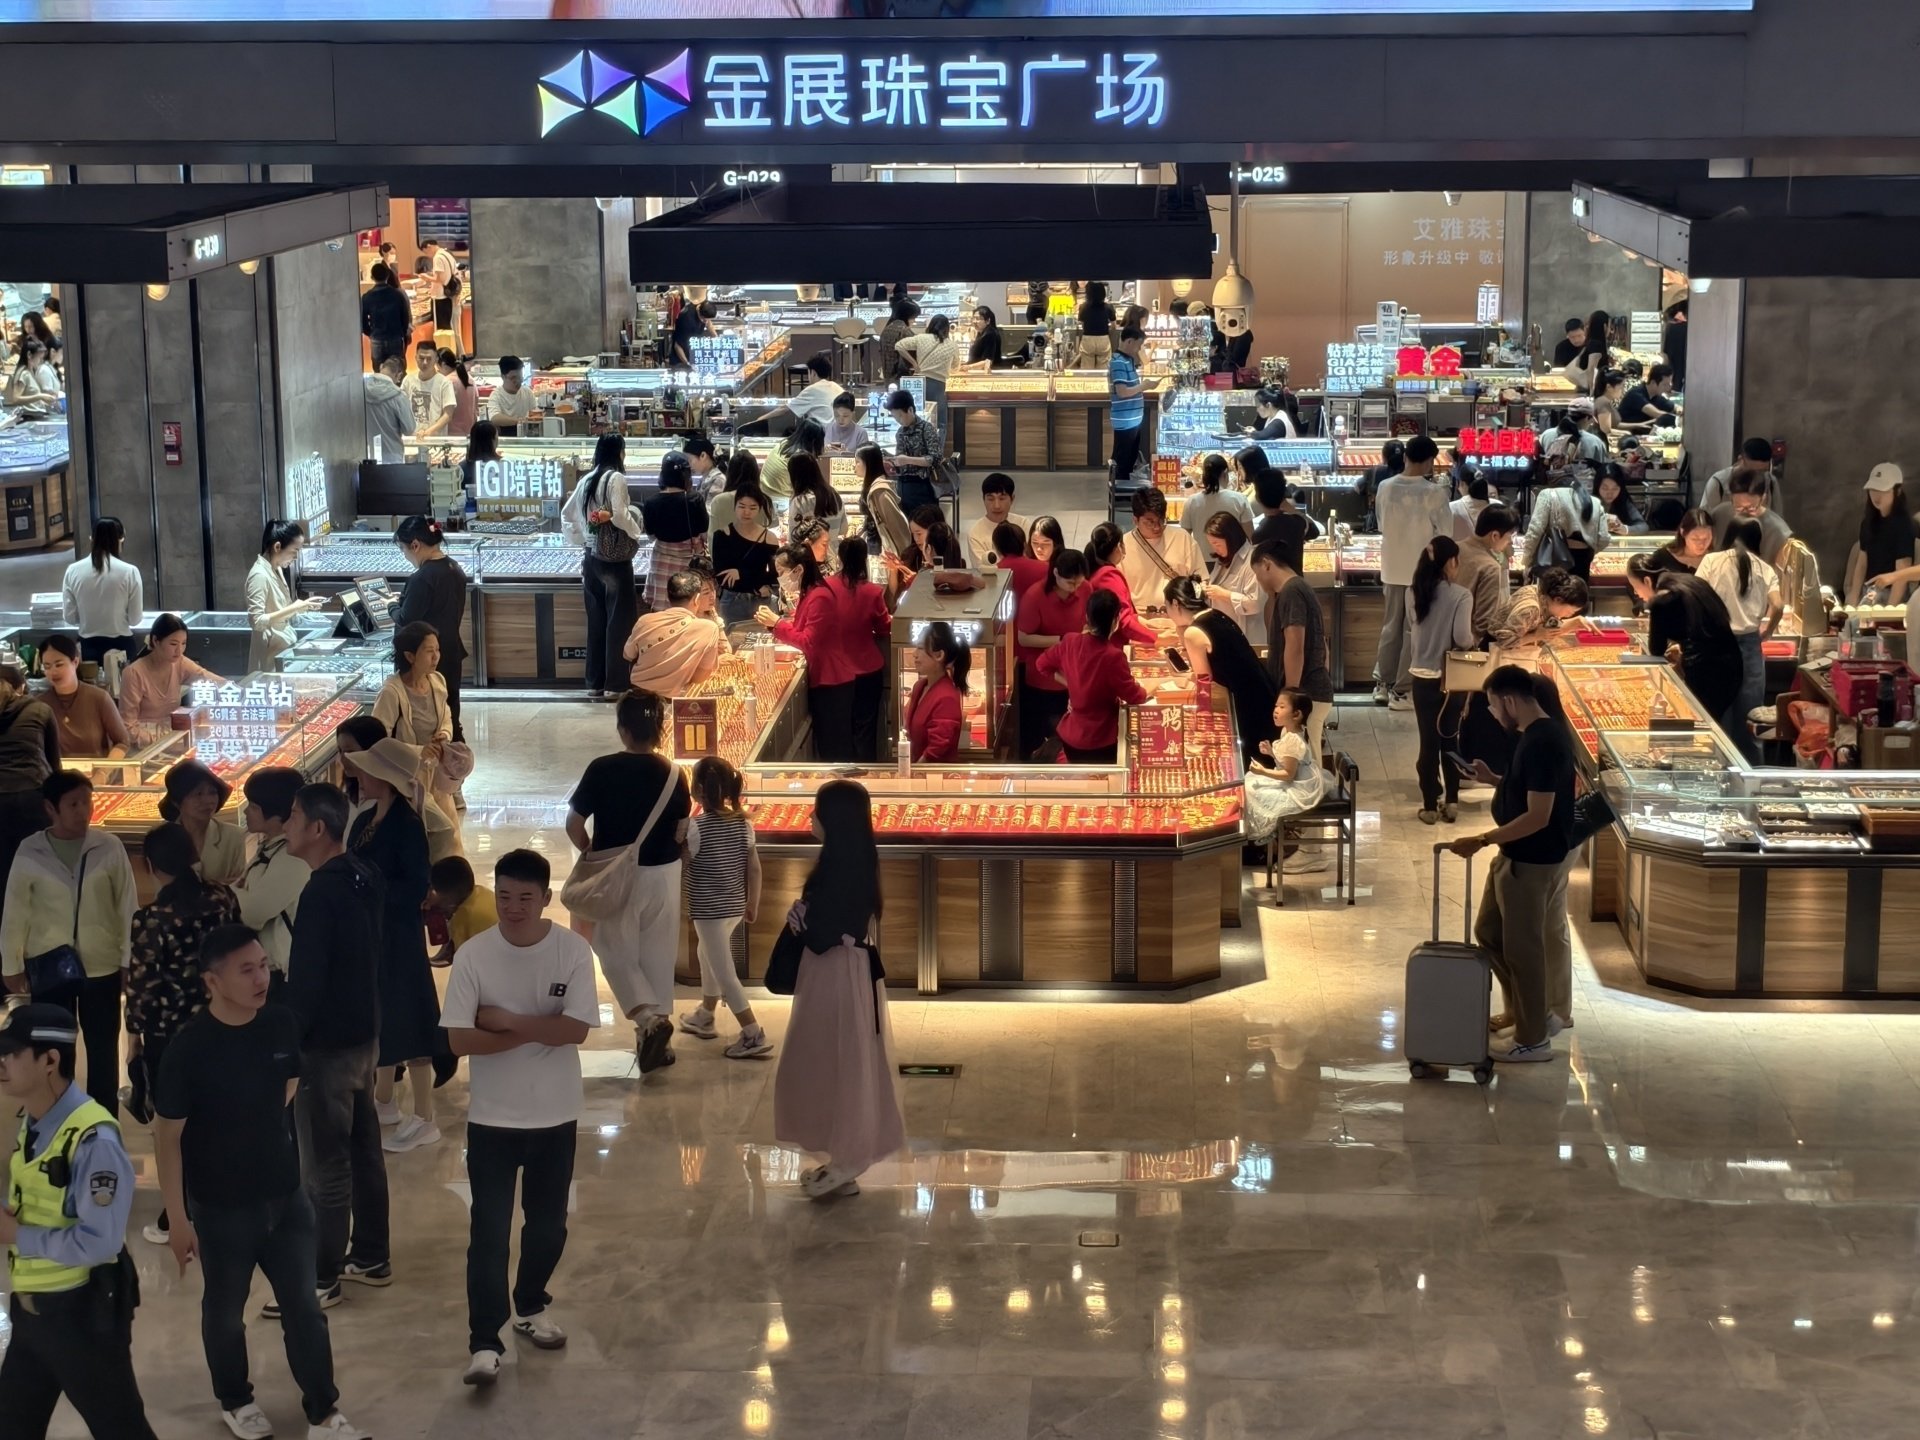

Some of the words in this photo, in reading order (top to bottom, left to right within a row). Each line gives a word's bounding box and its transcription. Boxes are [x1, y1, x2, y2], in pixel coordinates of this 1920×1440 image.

[704, 53, 1165, 127] 金展珠宝广场
[723, 170, 780, 186] G-029
[1384, 249, 1469, 265] 形象升级中
[1396, 345, 1462, 376] 黄金
[1459, 428, 1534, 454] 黄金回收
[475, 460, 562, 498] IGI培育钻
[192, 680, 293, 707] 黄金点钻
[1161, 706, 1182, 732] 聘
